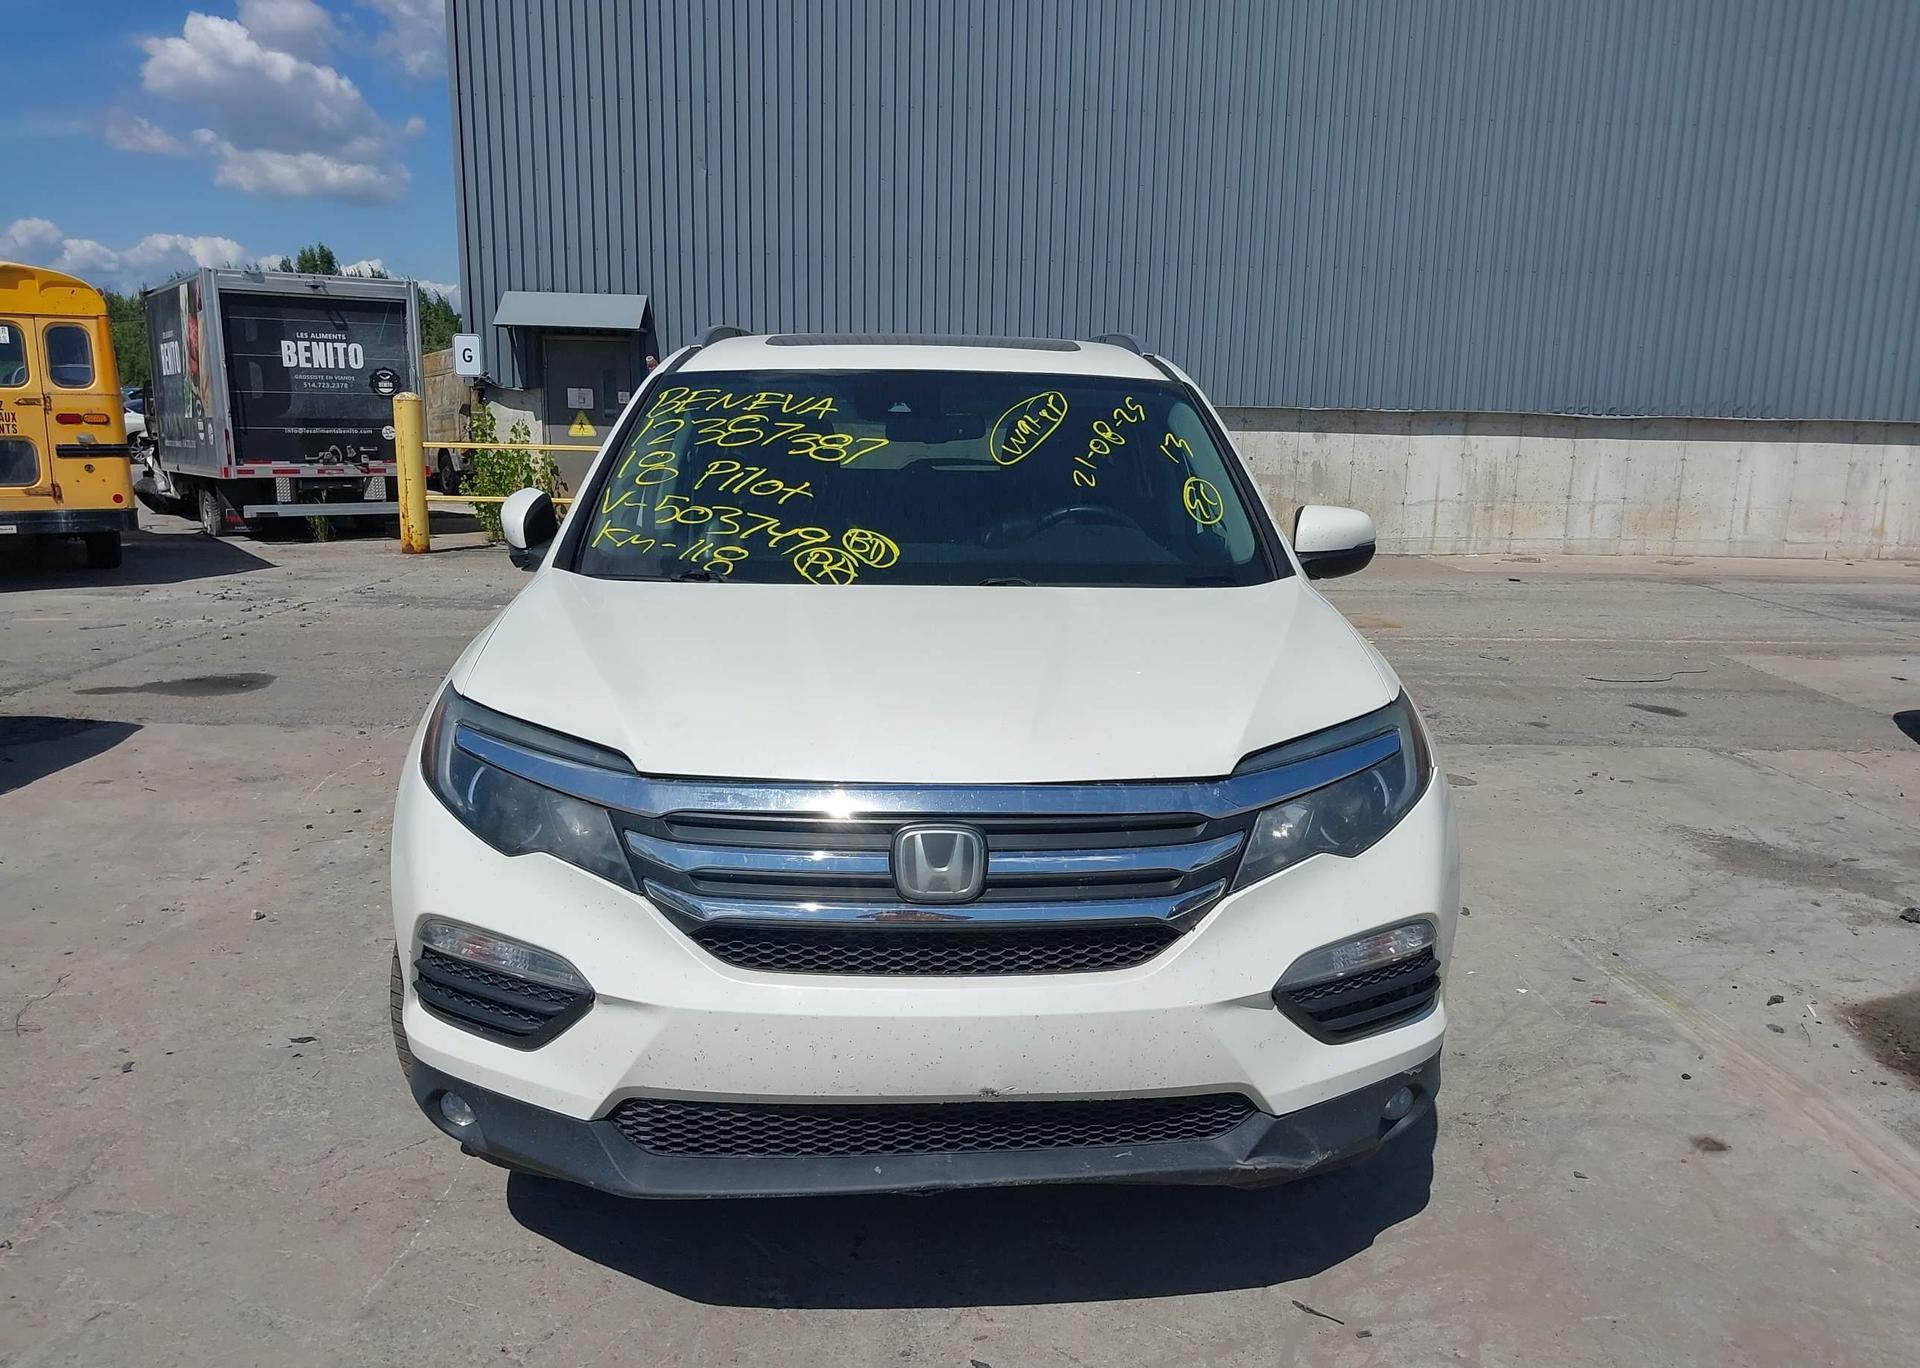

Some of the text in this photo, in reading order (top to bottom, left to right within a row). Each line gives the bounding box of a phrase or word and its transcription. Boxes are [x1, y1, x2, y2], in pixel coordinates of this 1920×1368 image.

[311, 332, 346, 340] ALIMENTS
[281, 340, 364, 369] BENITO
[462, 347, 473, 363] G
[646, 387, 839, 420] BENEVA
[618, 450, 679, 485] 18
